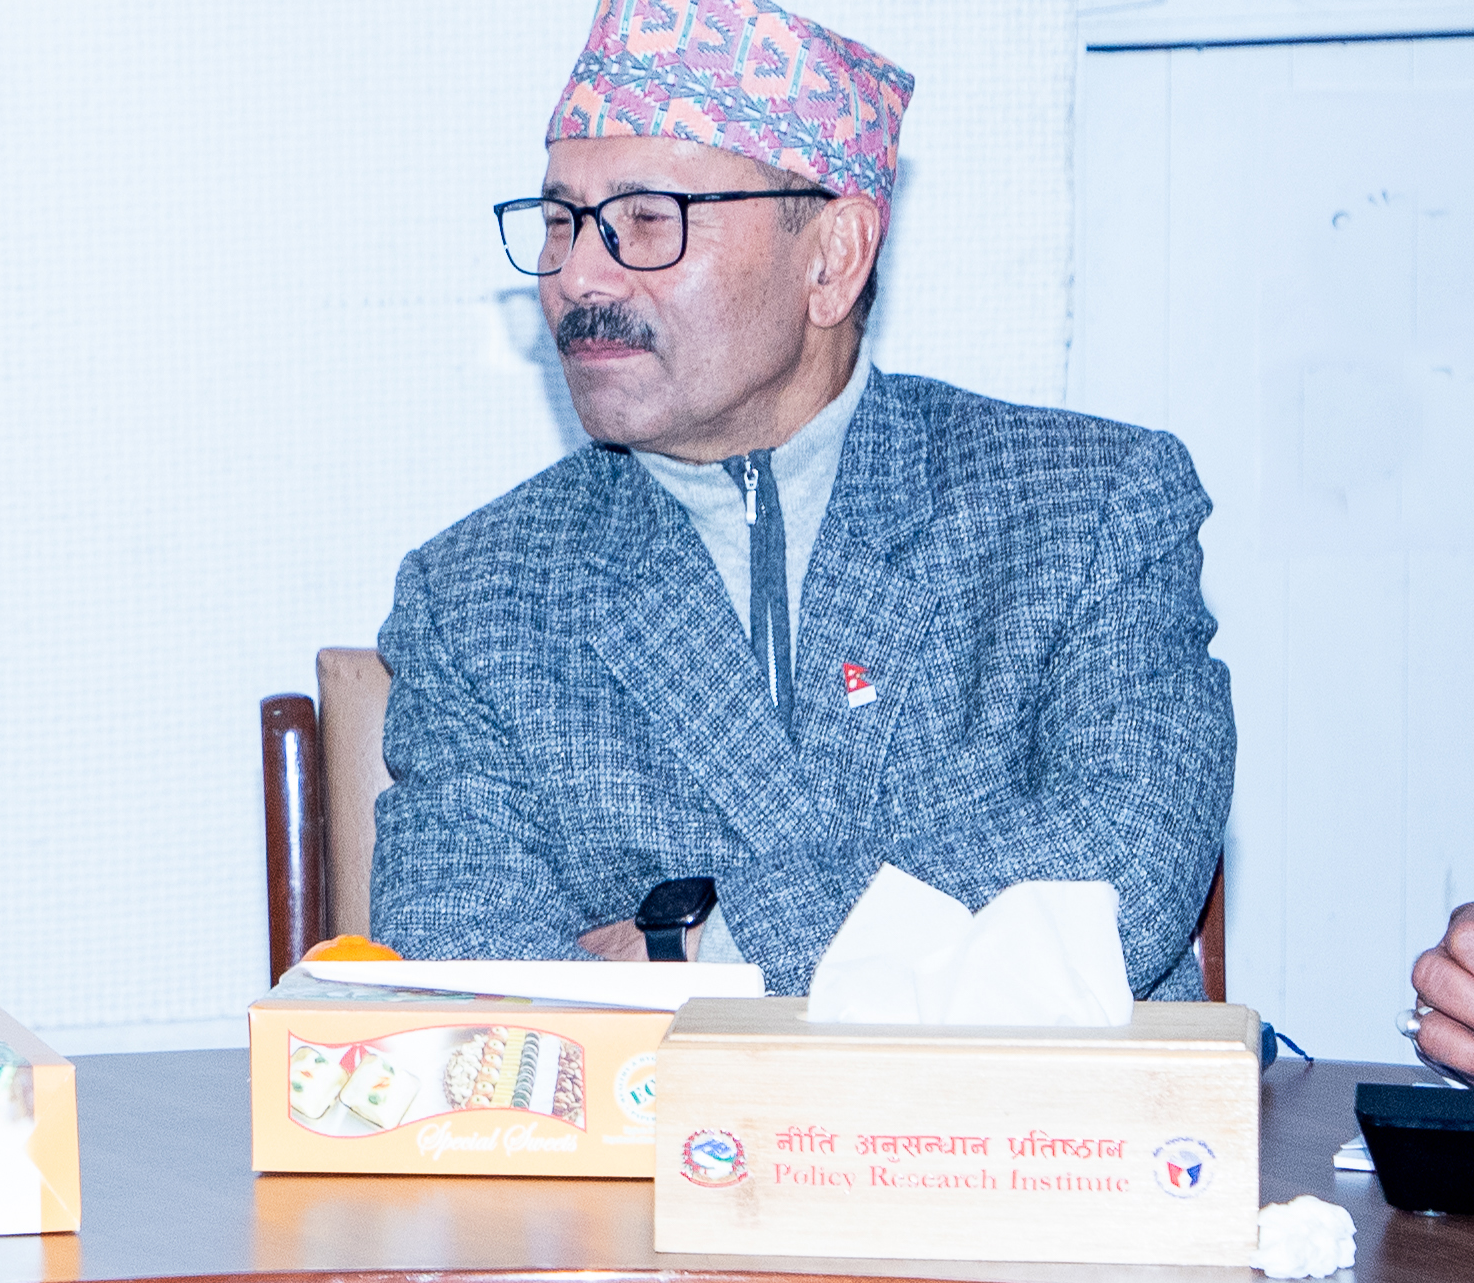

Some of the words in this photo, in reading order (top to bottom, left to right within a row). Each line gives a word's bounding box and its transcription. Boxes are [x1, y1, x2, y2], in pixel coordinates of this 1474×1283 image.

[629, 1078, 656, 1106] EC
[416, 1121, 501, 1161] Special
[503, 1122, 578, 1156] Sweets
[775, 1126, 840, 1155] नीति
[854, 1132, 992, 1163] अनुसन्धान
[1007, 1128, 1128, 1161] प्रतिष्ठान
[773, 1162, 858, 1192] Policy
[869, 1165, 999, 1191] Research
[1009, 1168, 1131, 1194] Institute
